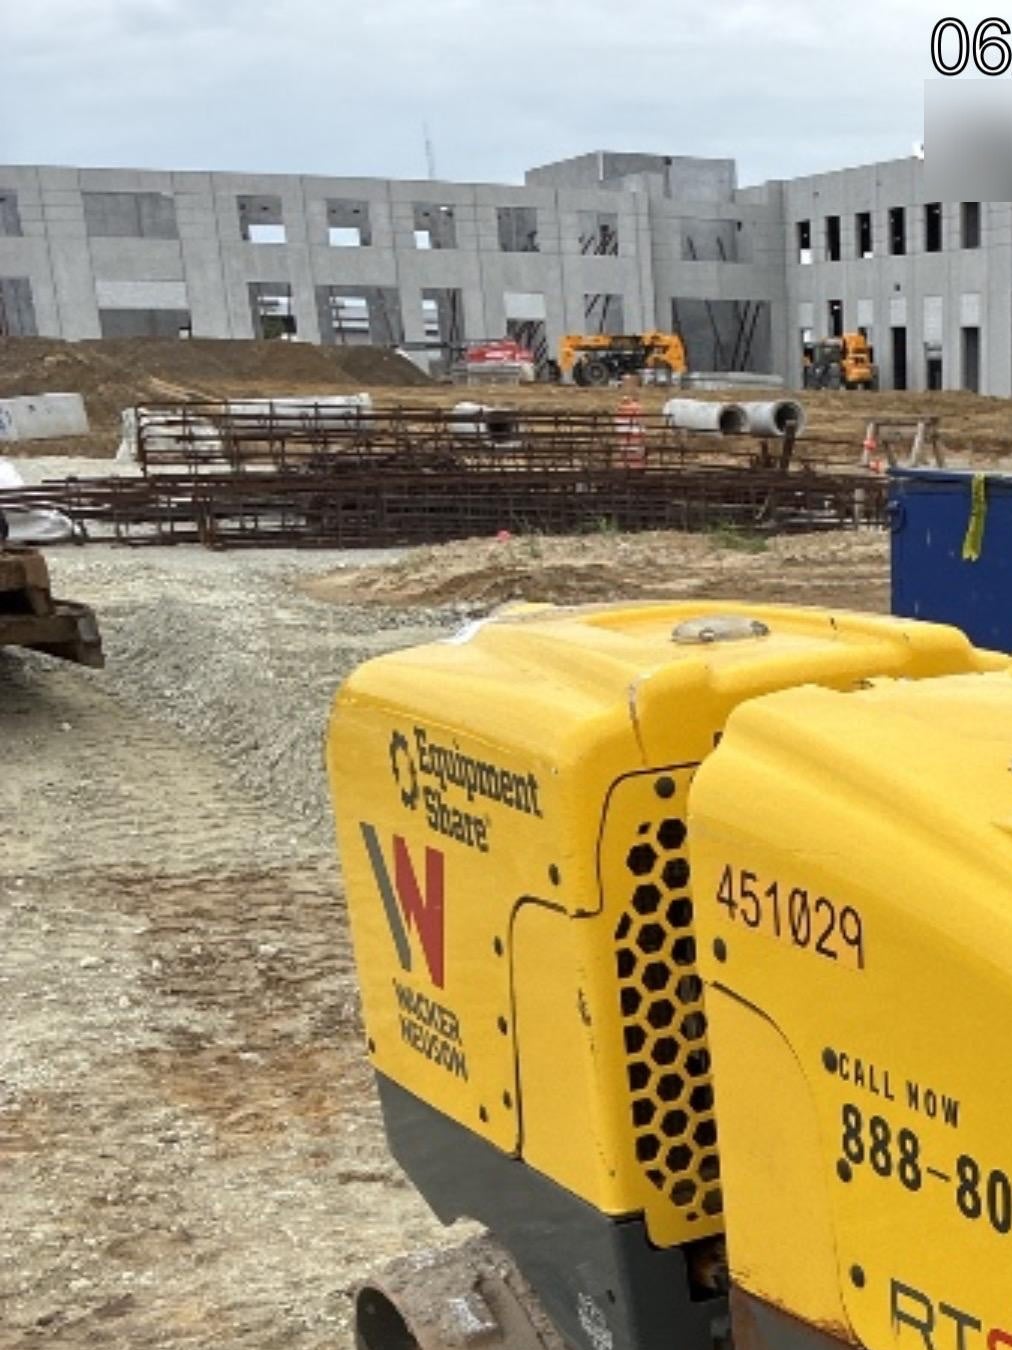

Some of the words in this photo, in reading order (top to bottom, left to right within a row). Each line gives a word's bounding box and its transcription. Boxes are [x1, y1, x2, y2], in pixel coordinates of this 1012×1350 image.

[413, 726, 544, 818] Equipment
[422, 785, 489, 852] Share
[716, 864, 865, 969] 451029
[392, 977, 463, 1046] WACKER
[399, 1013, 469, 1082] NEUSON
[838, 1051, 895, 1101] CALL
[905, 1080, 961, 1128] NOW
